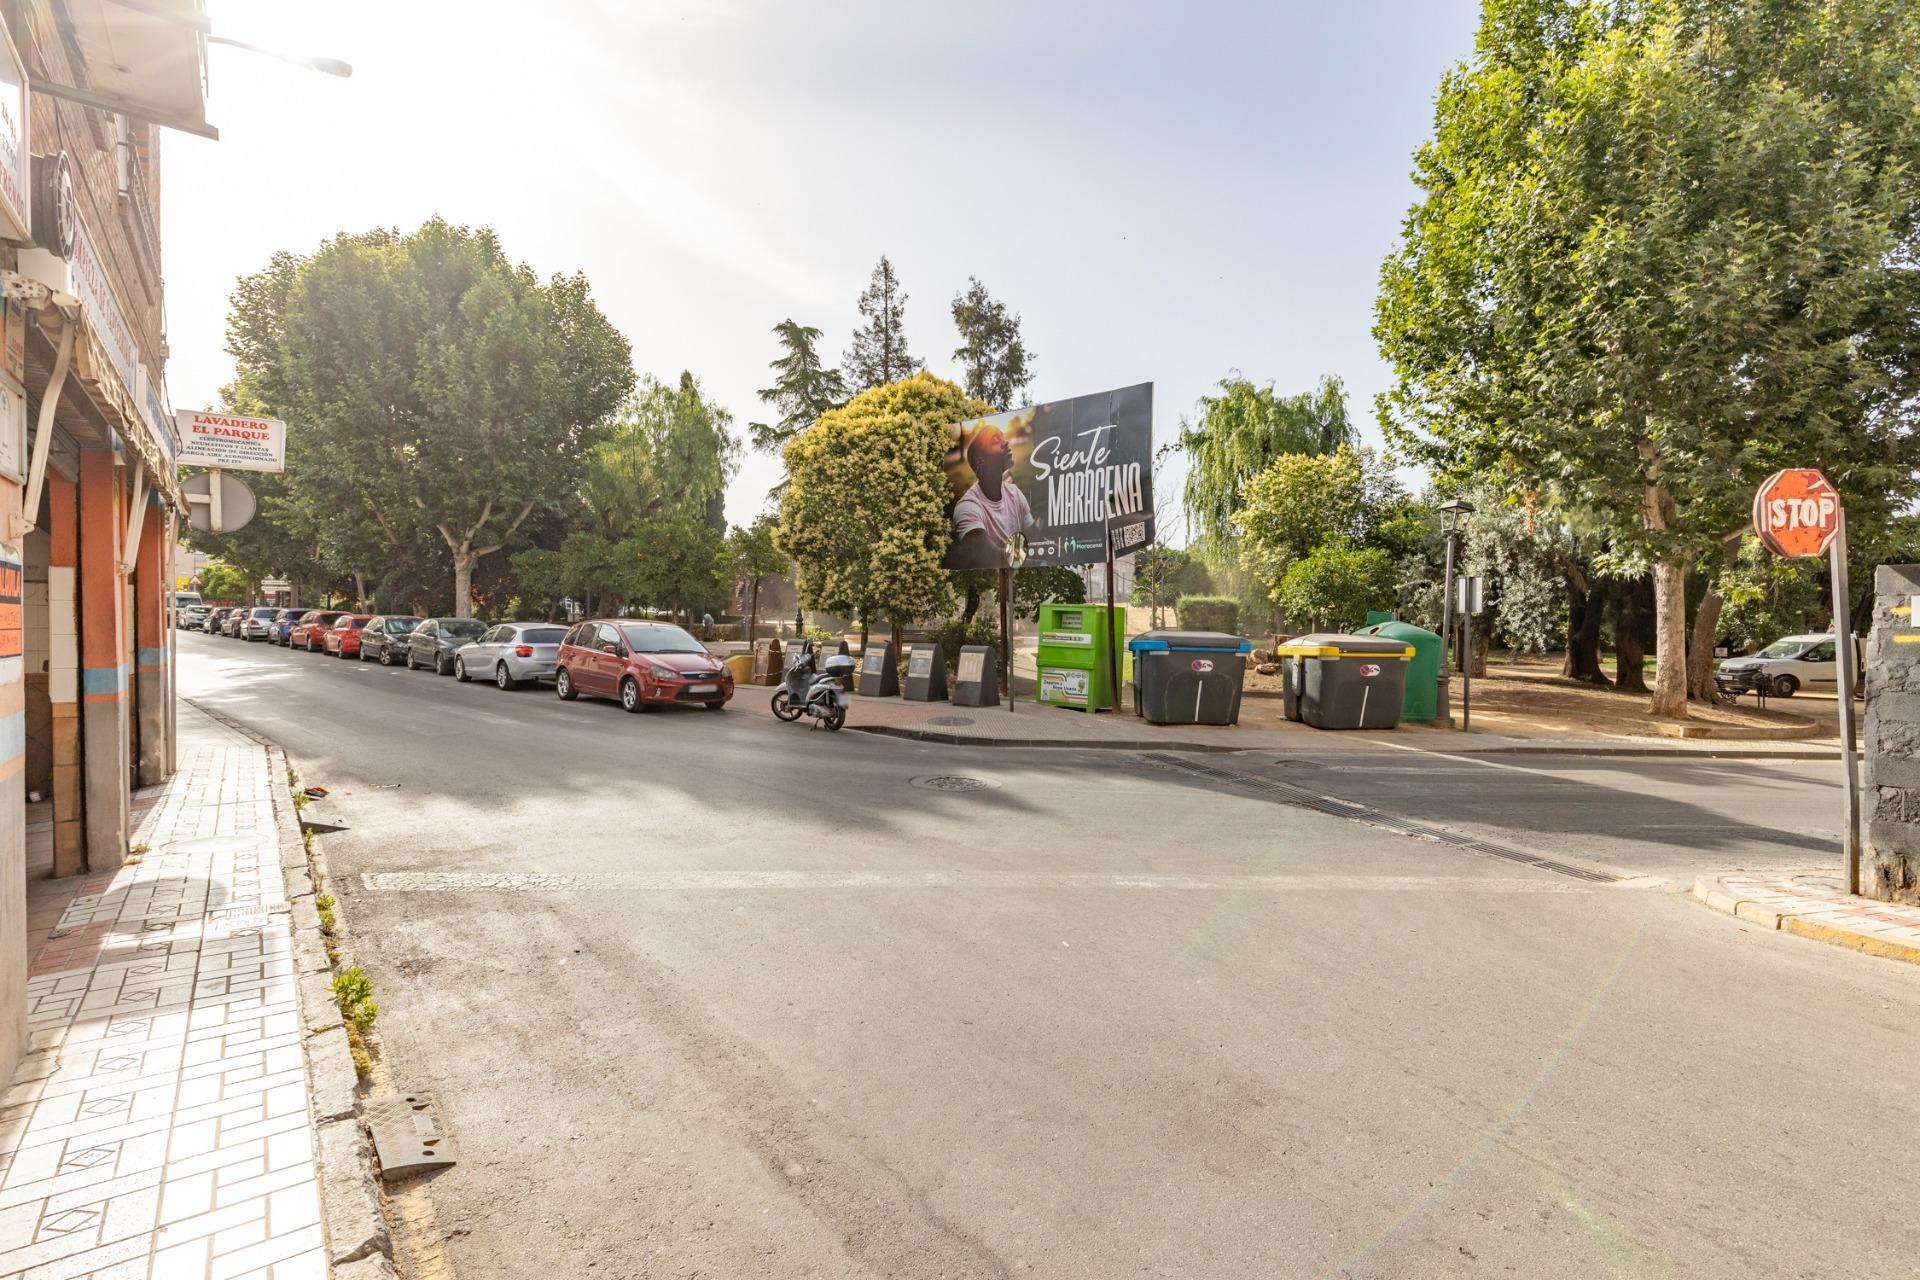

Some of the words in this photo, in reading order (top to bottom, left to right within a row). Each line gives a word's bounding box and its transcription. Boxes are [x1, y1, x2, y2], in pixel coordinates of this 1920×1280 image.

[192, 425, 210, 434] EL
[214, 428, 270, 440] PARQUE
[194, 415, 268, 430] LAVADERO
[224, 454, 278, 463] ACONDICIONADO
[1029, 424, 1117, 481] Siente
[1047, 462, 1144, 527] MARACENA
[1771, 498, 1836, 531] STOP
